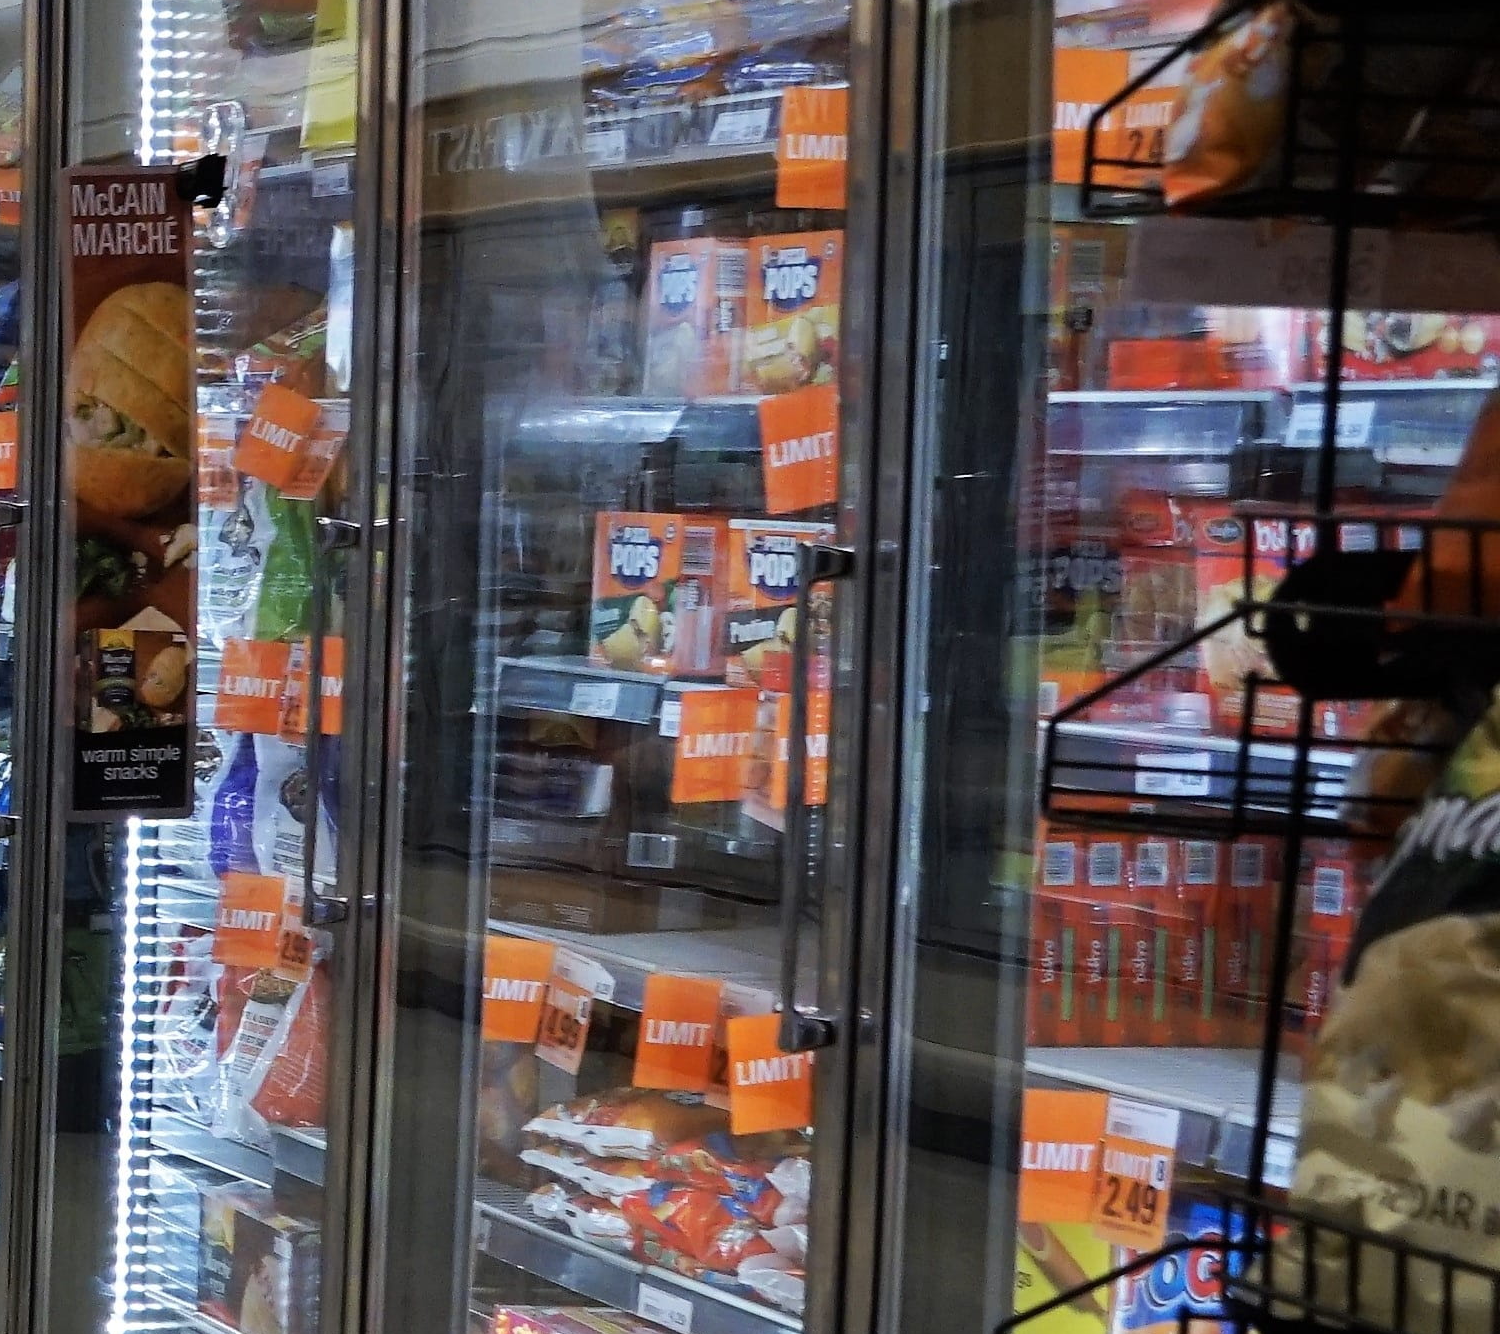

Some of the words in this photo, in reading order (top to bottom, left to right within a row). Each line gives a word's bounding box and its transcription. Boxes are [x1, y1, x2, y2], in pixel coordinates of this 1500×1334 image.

[787, 133, 847, 161] LIMIT
[72, 181, 167, 216] McCAIN
[72, 219, 180, 257] MARCHÉ
[763, 264, 820, 302] POPS
[253, 416, 303, 454] LIMIT
[769, 431, 835, 468] LIMIT
[610, 543, 660, 578] POPS
[750, 552, 799, 586] POP
[225, 676, 280, 698] LIMIT
[82, 747, 126, 764] warm
[130, 744, 181, 765] simple
[683, 733, 750, 758] LIMIT
[103, 763, 159, 781] snacks
[220, 908, 276, 932] LIMIT
[646, 1019, 711, 1047] LIMIT
[735, 1053, 806, 1086] LIMIT
[1022, 1140, 1095, 1173] LIMIT
[1104, 1149, 1152, 1180] LIMIT
